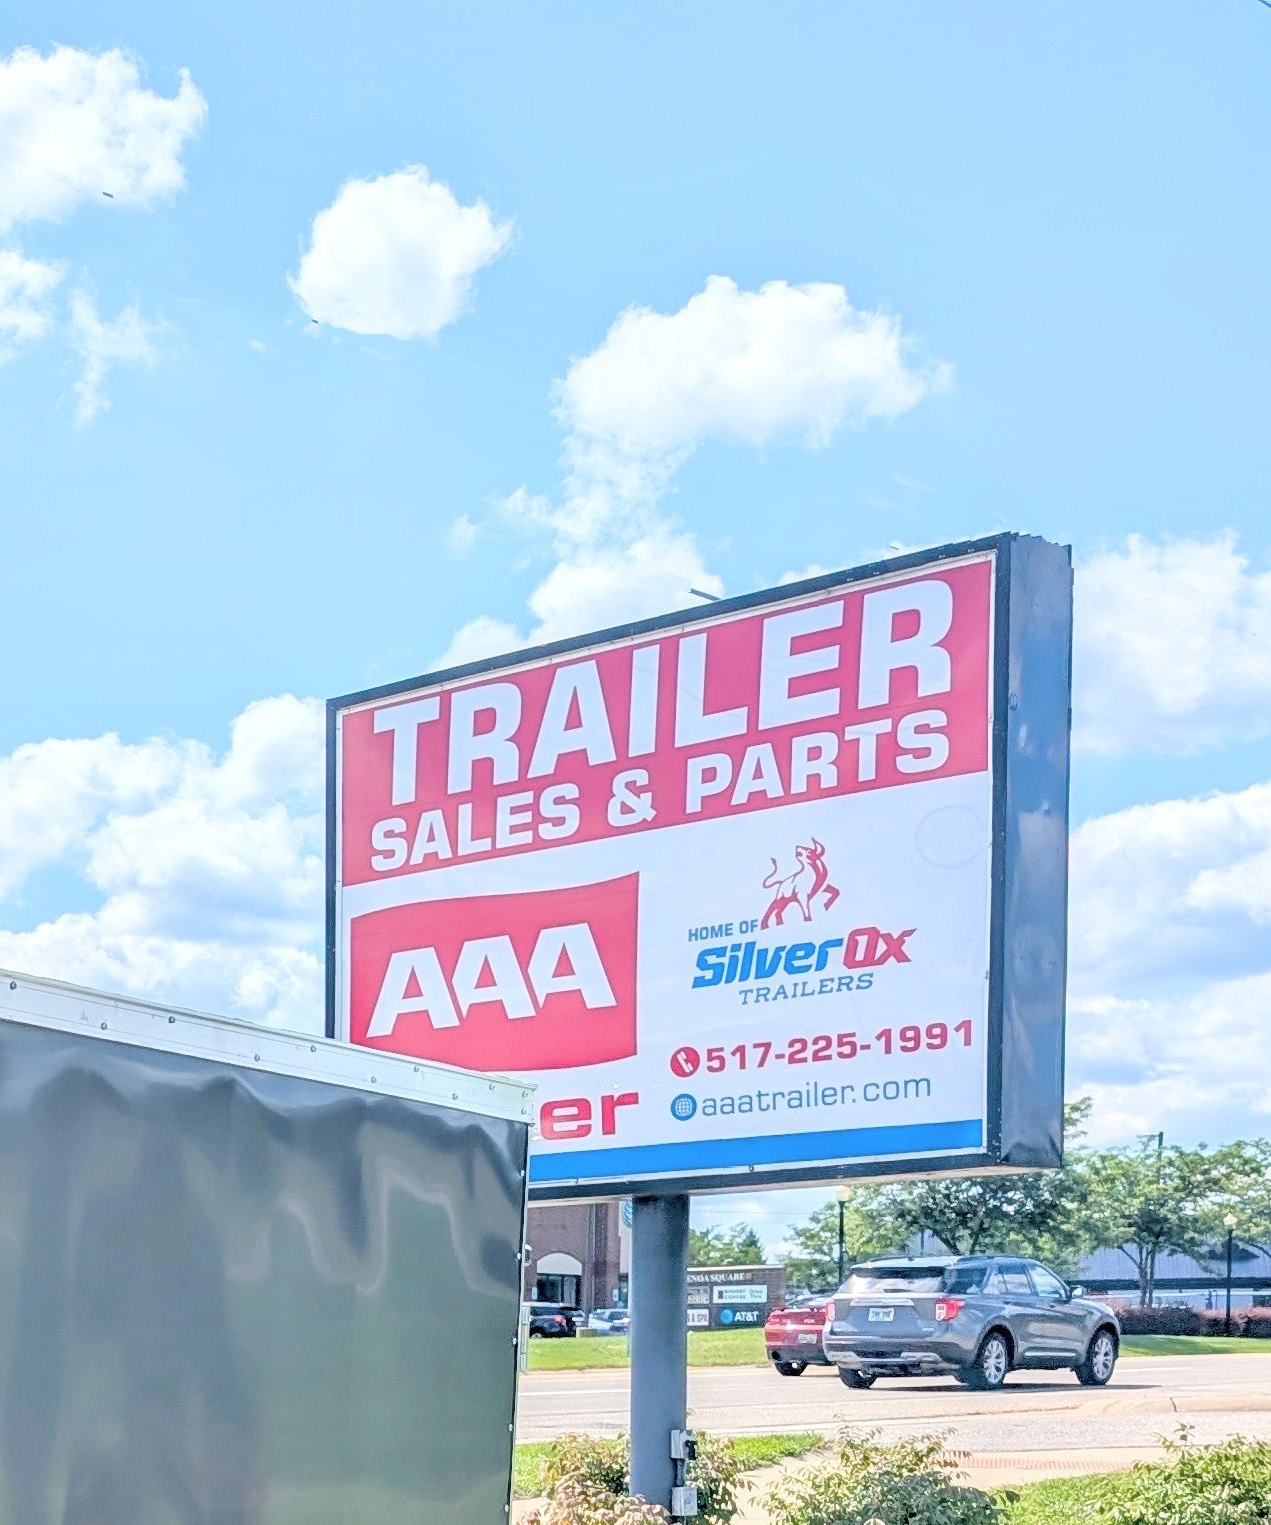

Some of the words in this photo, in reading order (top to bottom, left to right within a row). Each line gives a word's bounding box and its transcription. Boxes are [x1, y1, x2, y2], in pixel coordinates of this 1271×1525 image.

[373, 580, 954, 806] TRAILER
[370, 781, 579, 873] SALES
[607, 766, 657, 828] &
[685, 708, 951, 814] PARTS
[688, 923, 734, 942] HOME
[738, 918, 759, 935] OF
[366, 922, 617, 1038] AAA
[738, 972, 875, 1006] TRAILERS
[706, 1019, 973, 1073] 517-225-1991
[701, 1076, 931, 1117] aaatrailer.com
[710, 1272, 746, 1283] SQUARE
[734, 1311, 759, 1322] AT&T
